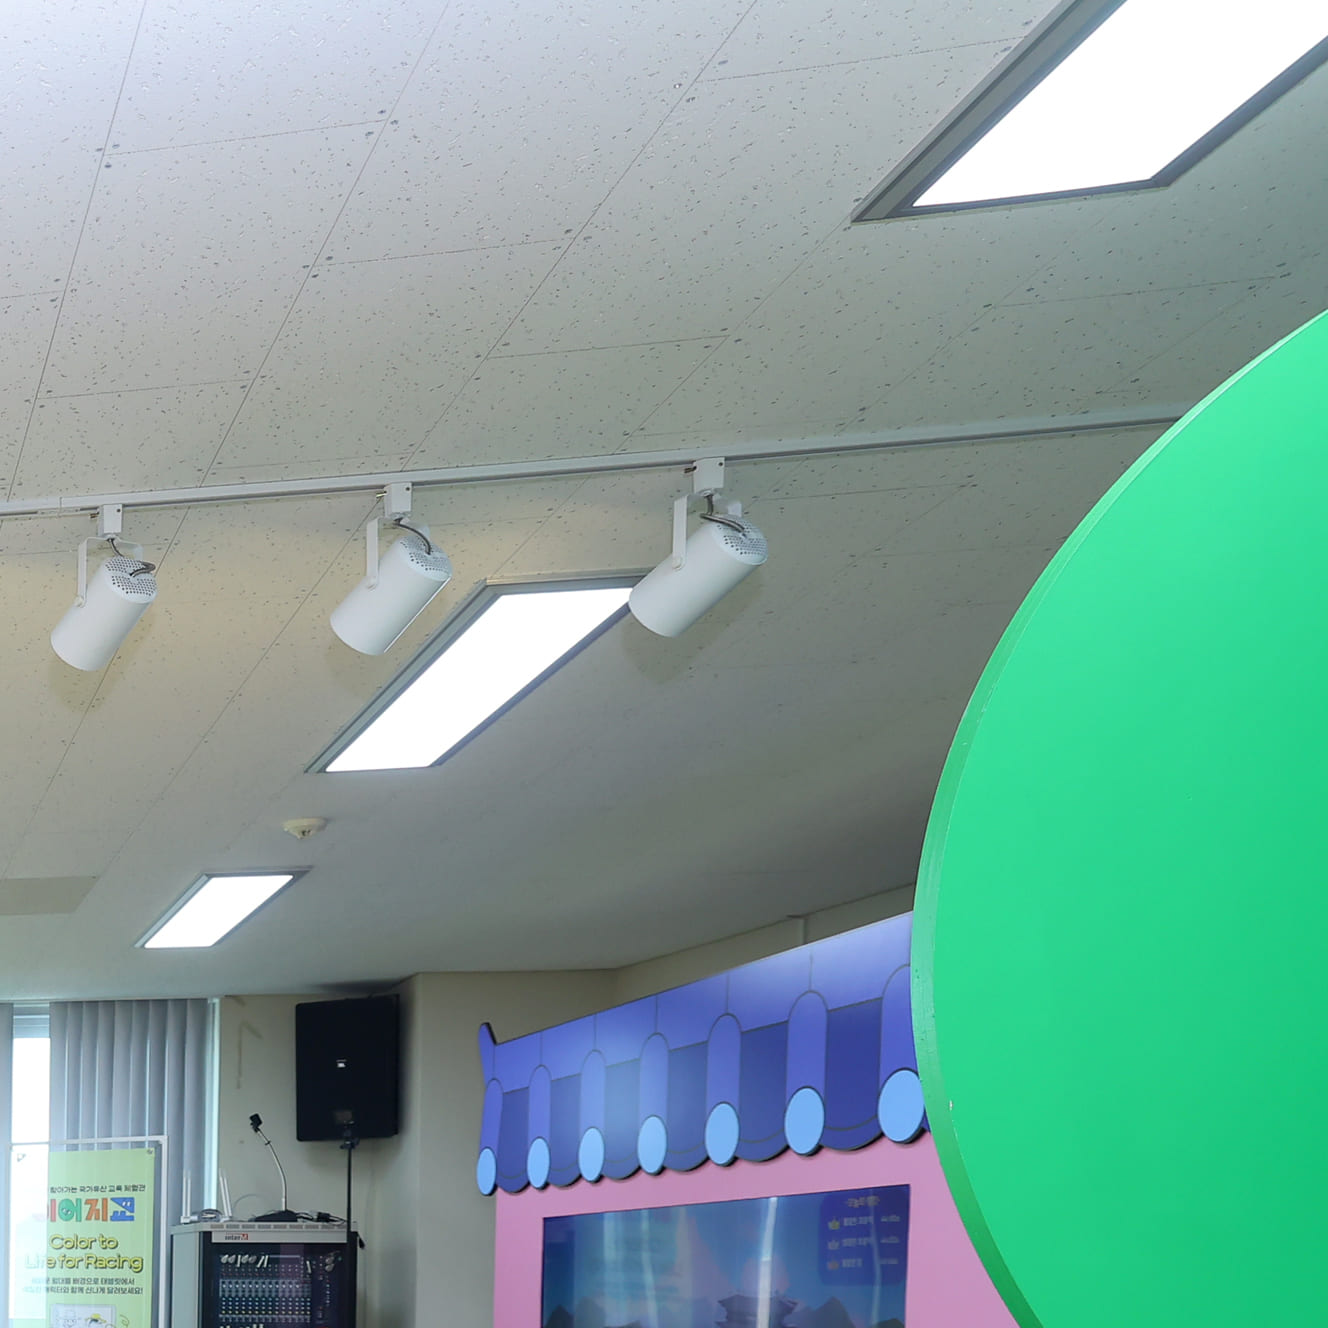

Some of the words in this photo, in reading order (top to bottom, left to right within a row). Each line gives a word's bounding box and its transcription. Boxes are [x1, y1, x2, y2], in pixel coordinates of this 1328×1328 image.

[50, 1233, 97, 1250] Color
[98, 1233, 119, 1250] to
[58, 1253, 84, 1269] for
[84, 1253, 144, 1274] Racing
